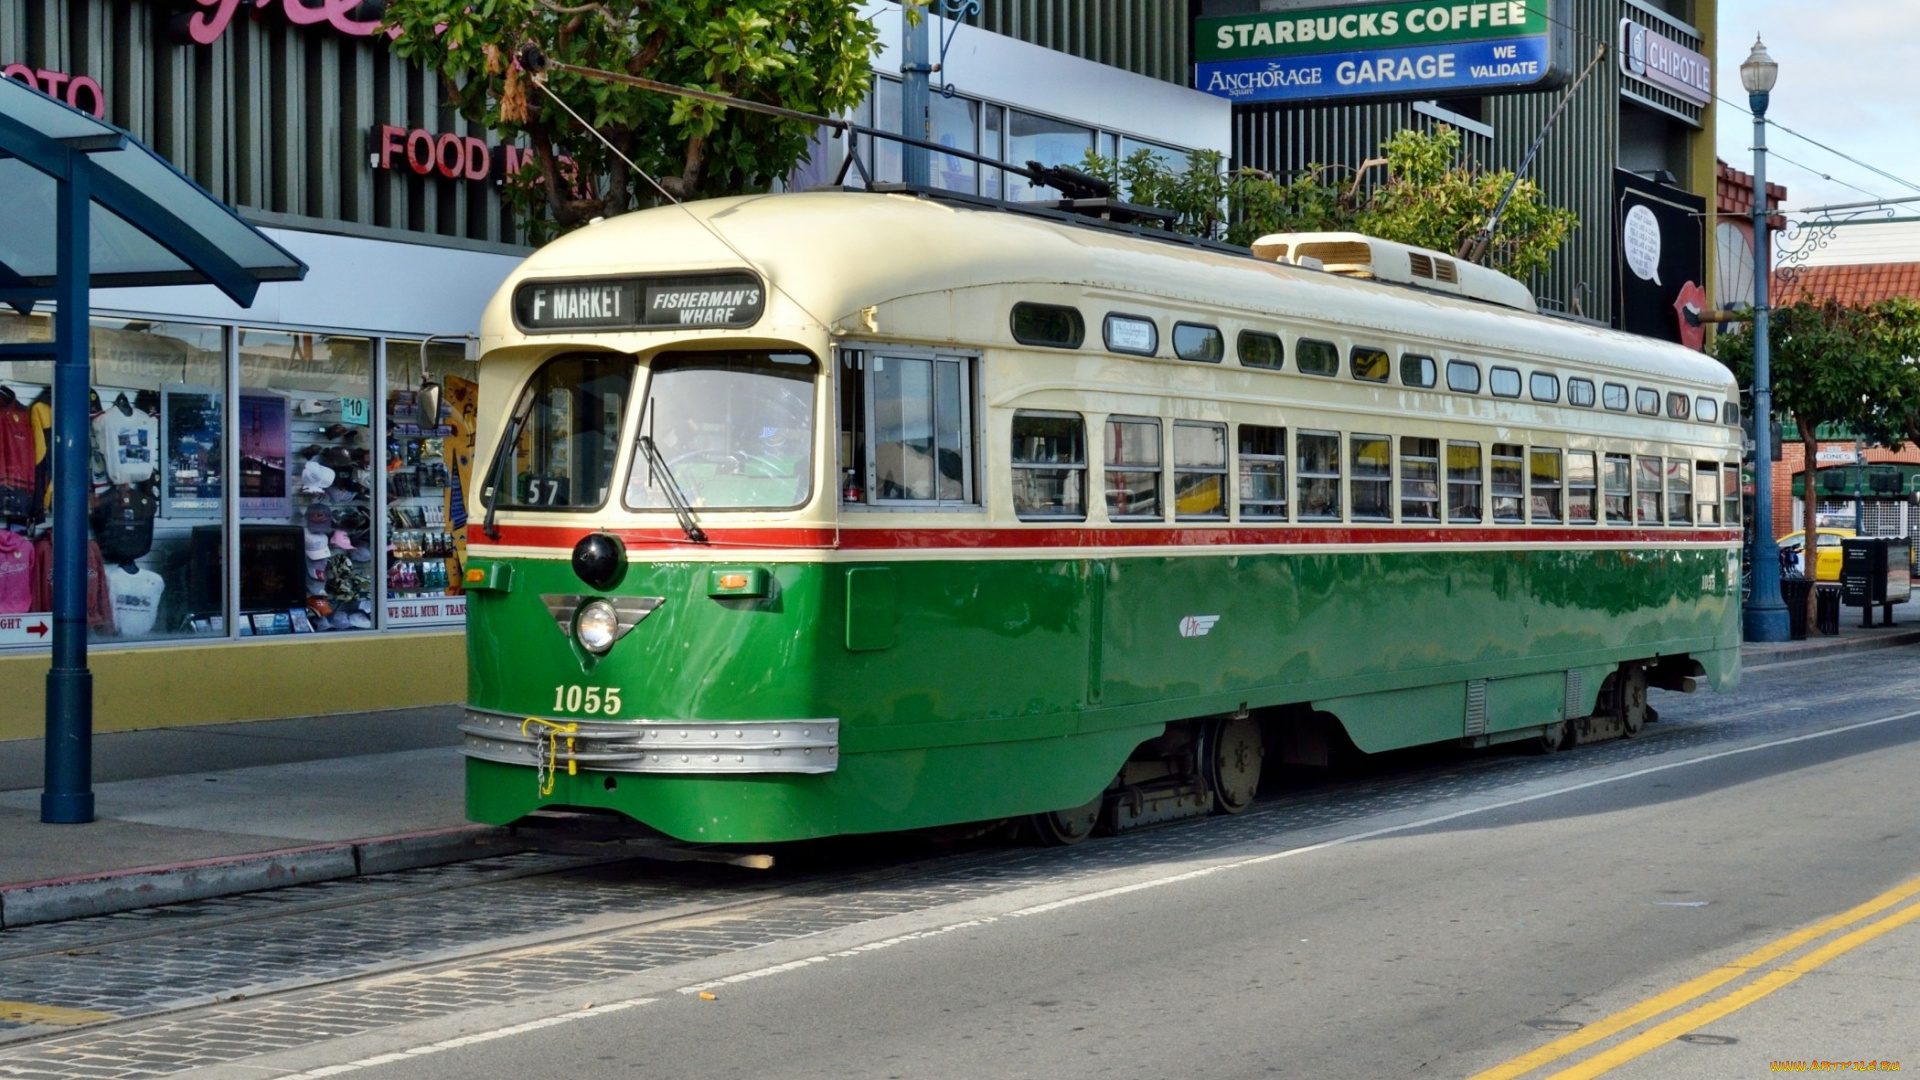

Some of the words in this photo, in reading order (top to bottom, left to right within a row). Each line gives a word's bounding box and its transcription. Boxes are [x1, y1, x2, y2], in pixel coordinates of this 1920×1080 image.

[1217, 11, 1399, 49] STARBUCKS
[1405, 1, 1526, 33] COFFEE
[1493, 46, 1516, 59] WE
[1336, 54, 1455, 85] GARAGE
[1470, 61, 1538, 78] VALIDATE
[1649, 42, 1710, 92] CHIPOTLE
[1228, 87, 1254, 97] Square
[381, 124, 490, 181] FOOD
[533, 290, 546, 320] F
[553, 286, 622, 319] MARKET
[653, 289, 760, 309] FISHERMAN'S
[680, 307, 735, 324] WHARF
[1701, 574, 1716, 590] 1055
[387, 606, 399, 618] WE
[401, 606, 418, 618] SELL
[420, 605, 438, 617] MUNI
[553, 685, 621, 715] 1055
